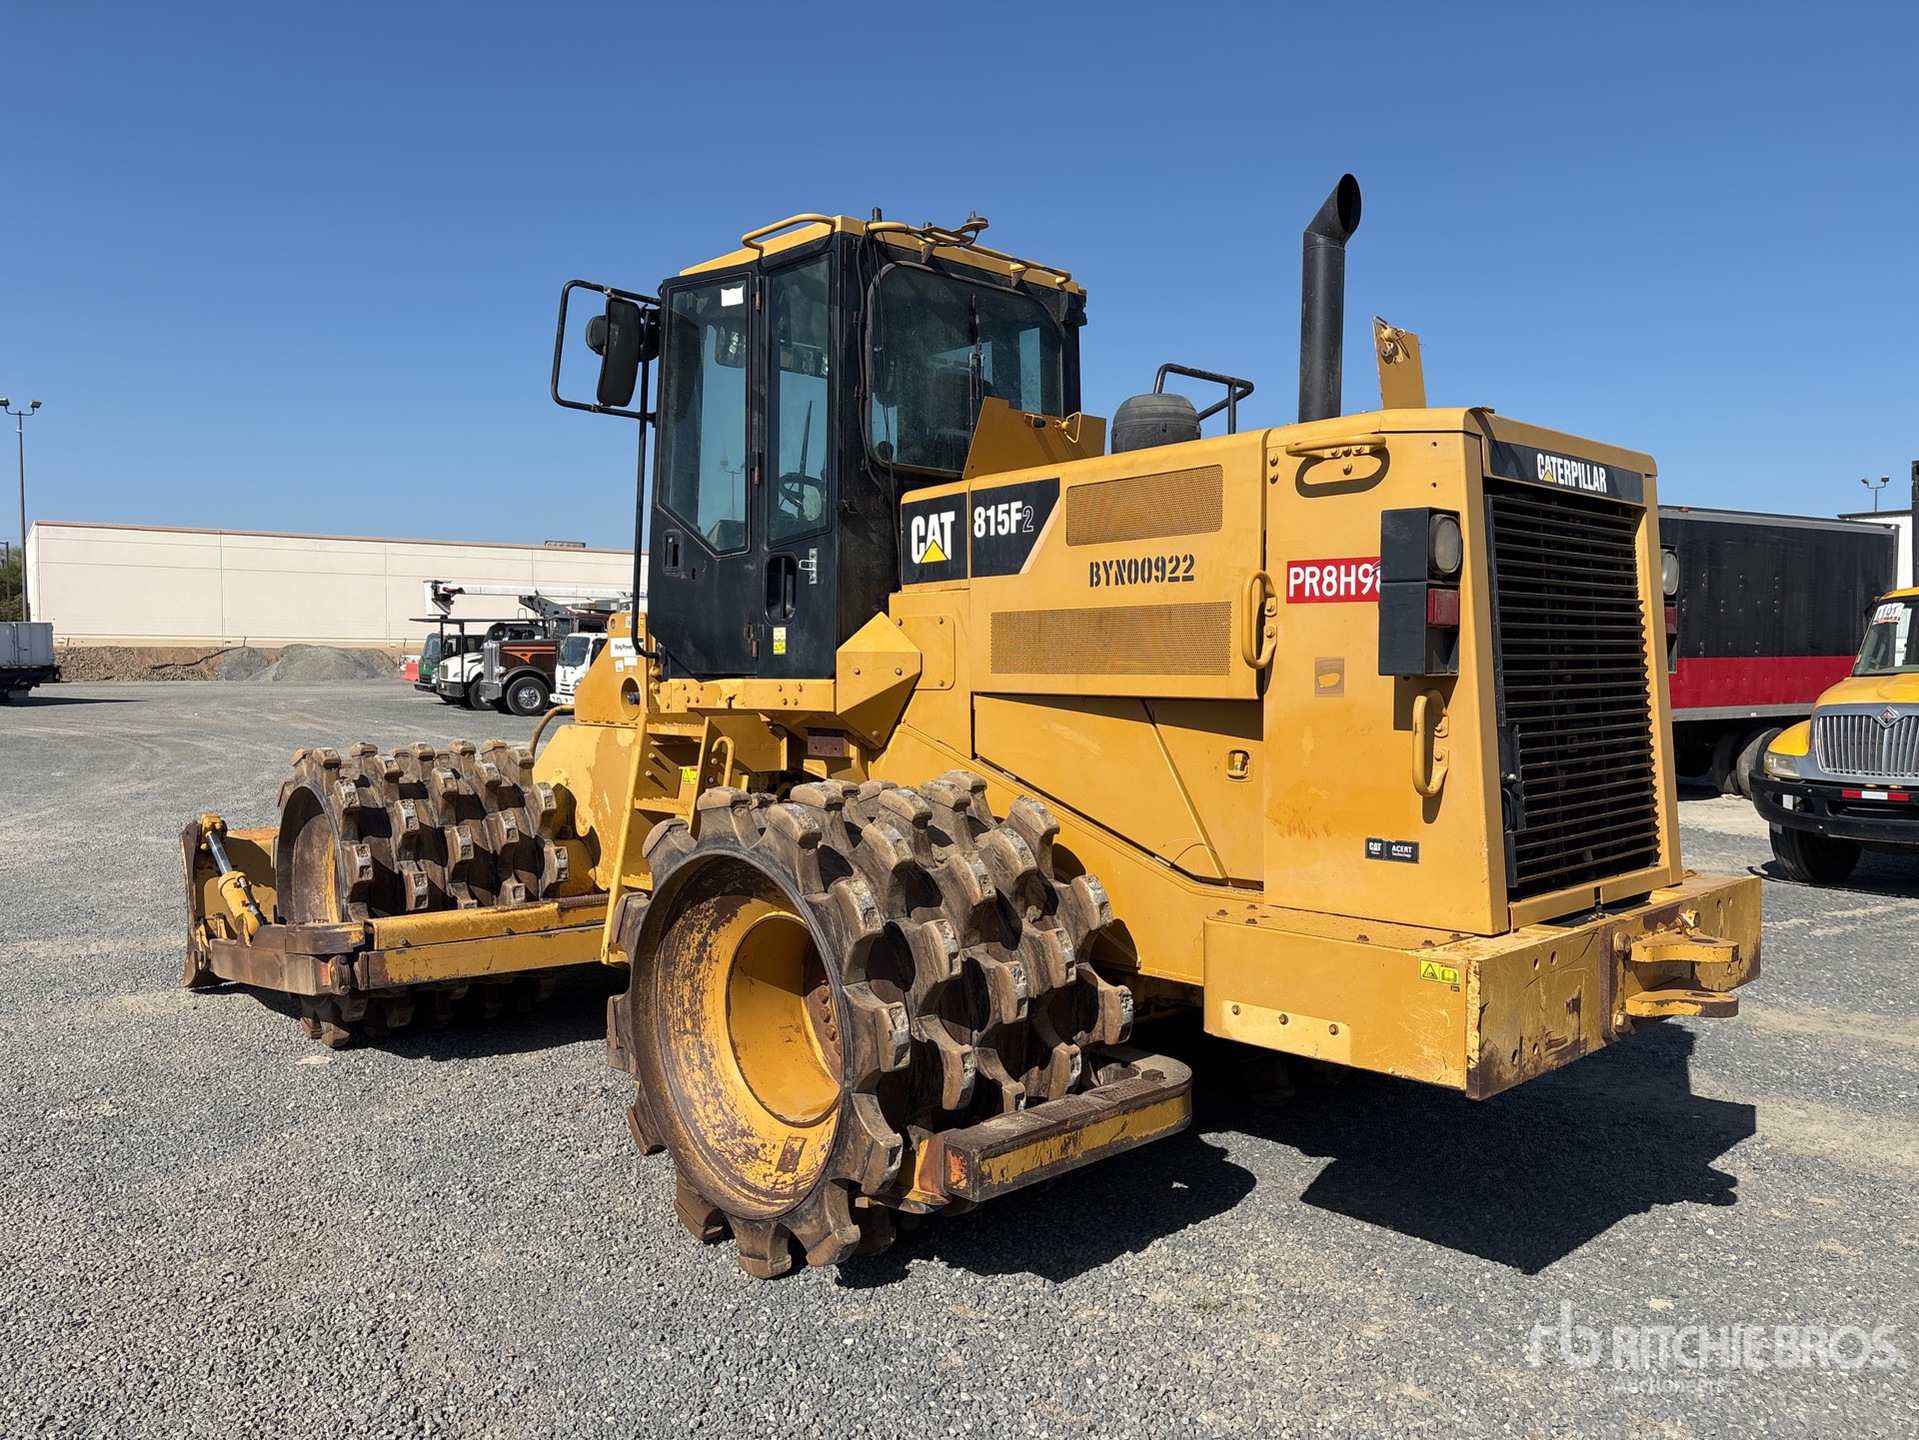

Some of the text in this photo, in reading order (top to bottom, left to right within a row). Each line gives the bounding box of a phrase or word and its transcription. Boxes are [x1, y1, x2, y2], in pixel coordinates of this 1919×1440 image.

[1537, 453, 1607, 493] CATERPILLAR
[911, 511, 955, 564] CAT
[1089, 553, 1195, 588] BYN00922
[1289, 563, 1380, 597] PR8H9
[1369, 842, 1413, 853] CAT ACERT
